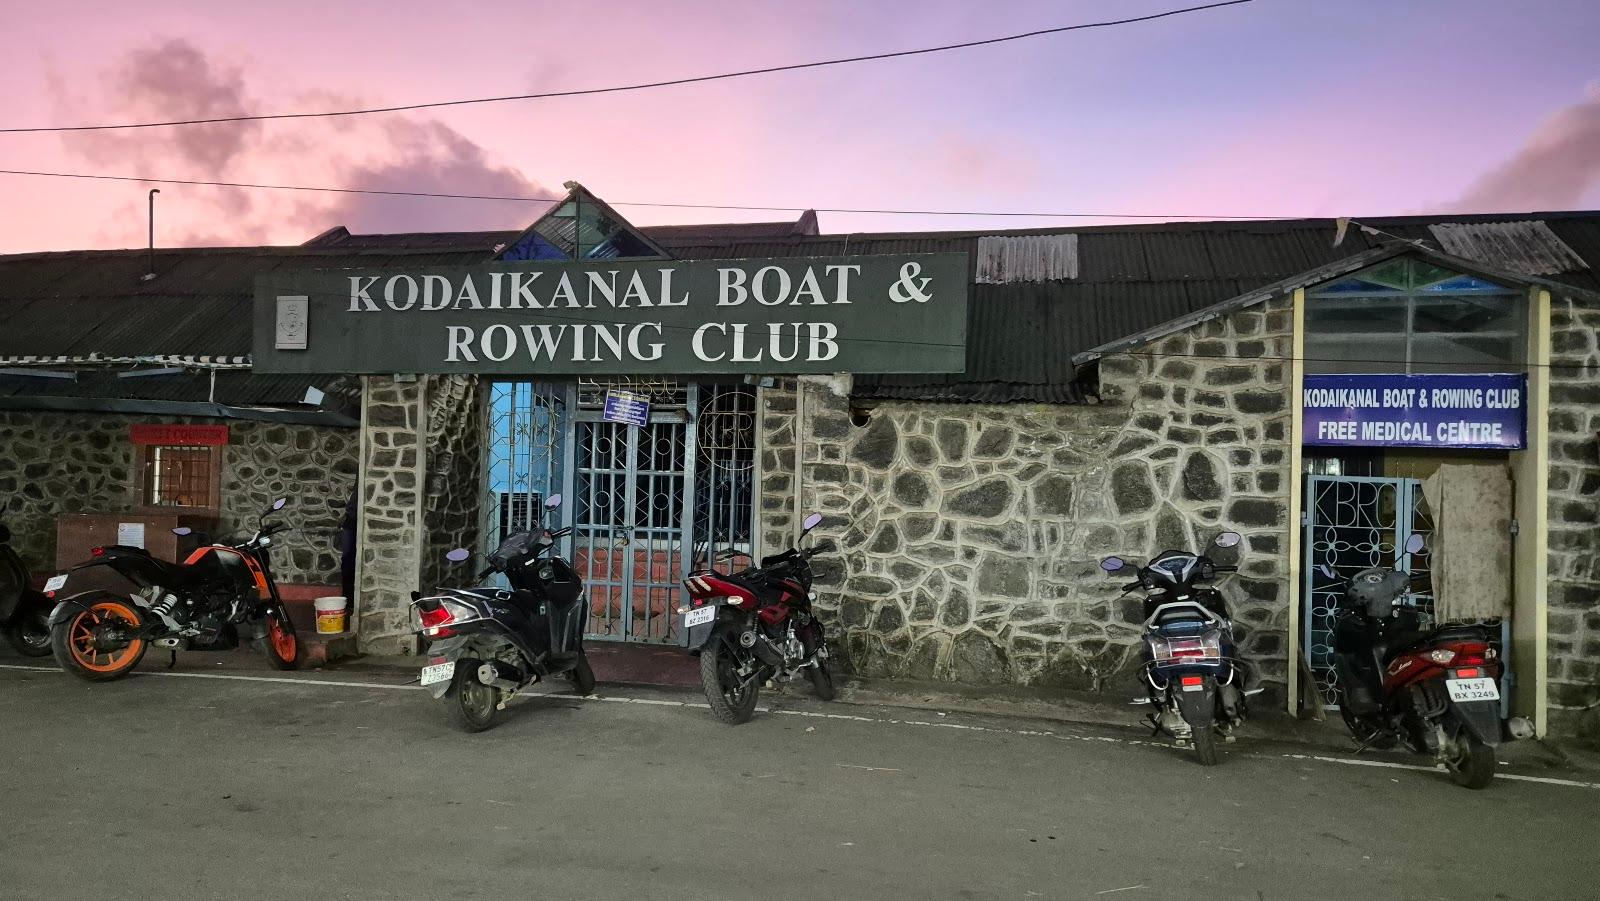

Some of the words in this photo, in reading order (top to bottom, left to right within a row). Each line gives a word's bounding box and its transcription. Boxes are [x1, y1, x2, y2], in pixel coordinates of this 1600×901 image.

[348, 269, 690, 311] KODAIKANAL
[716, 265, 861, 306] BOAT
[888, 261, 933, 303] &
[445, 323, 666, 362] ROWING
[691, 322, 839, 362] CLUB
[1303, 388, 1380, 409] KODAIKANAL
[1383, 388, 1416, 409] BOAT
[1418, 388, 1428, 409] &
[1431, 388, 1483, 409] ROWING
[1485, 388, 1520, 409] CLUB
[1318, 421, 1358, 441] FREE
[1361, 421, 1432, 442] MEDICAL
[1436, 421, 1503, 442] CENTRE
